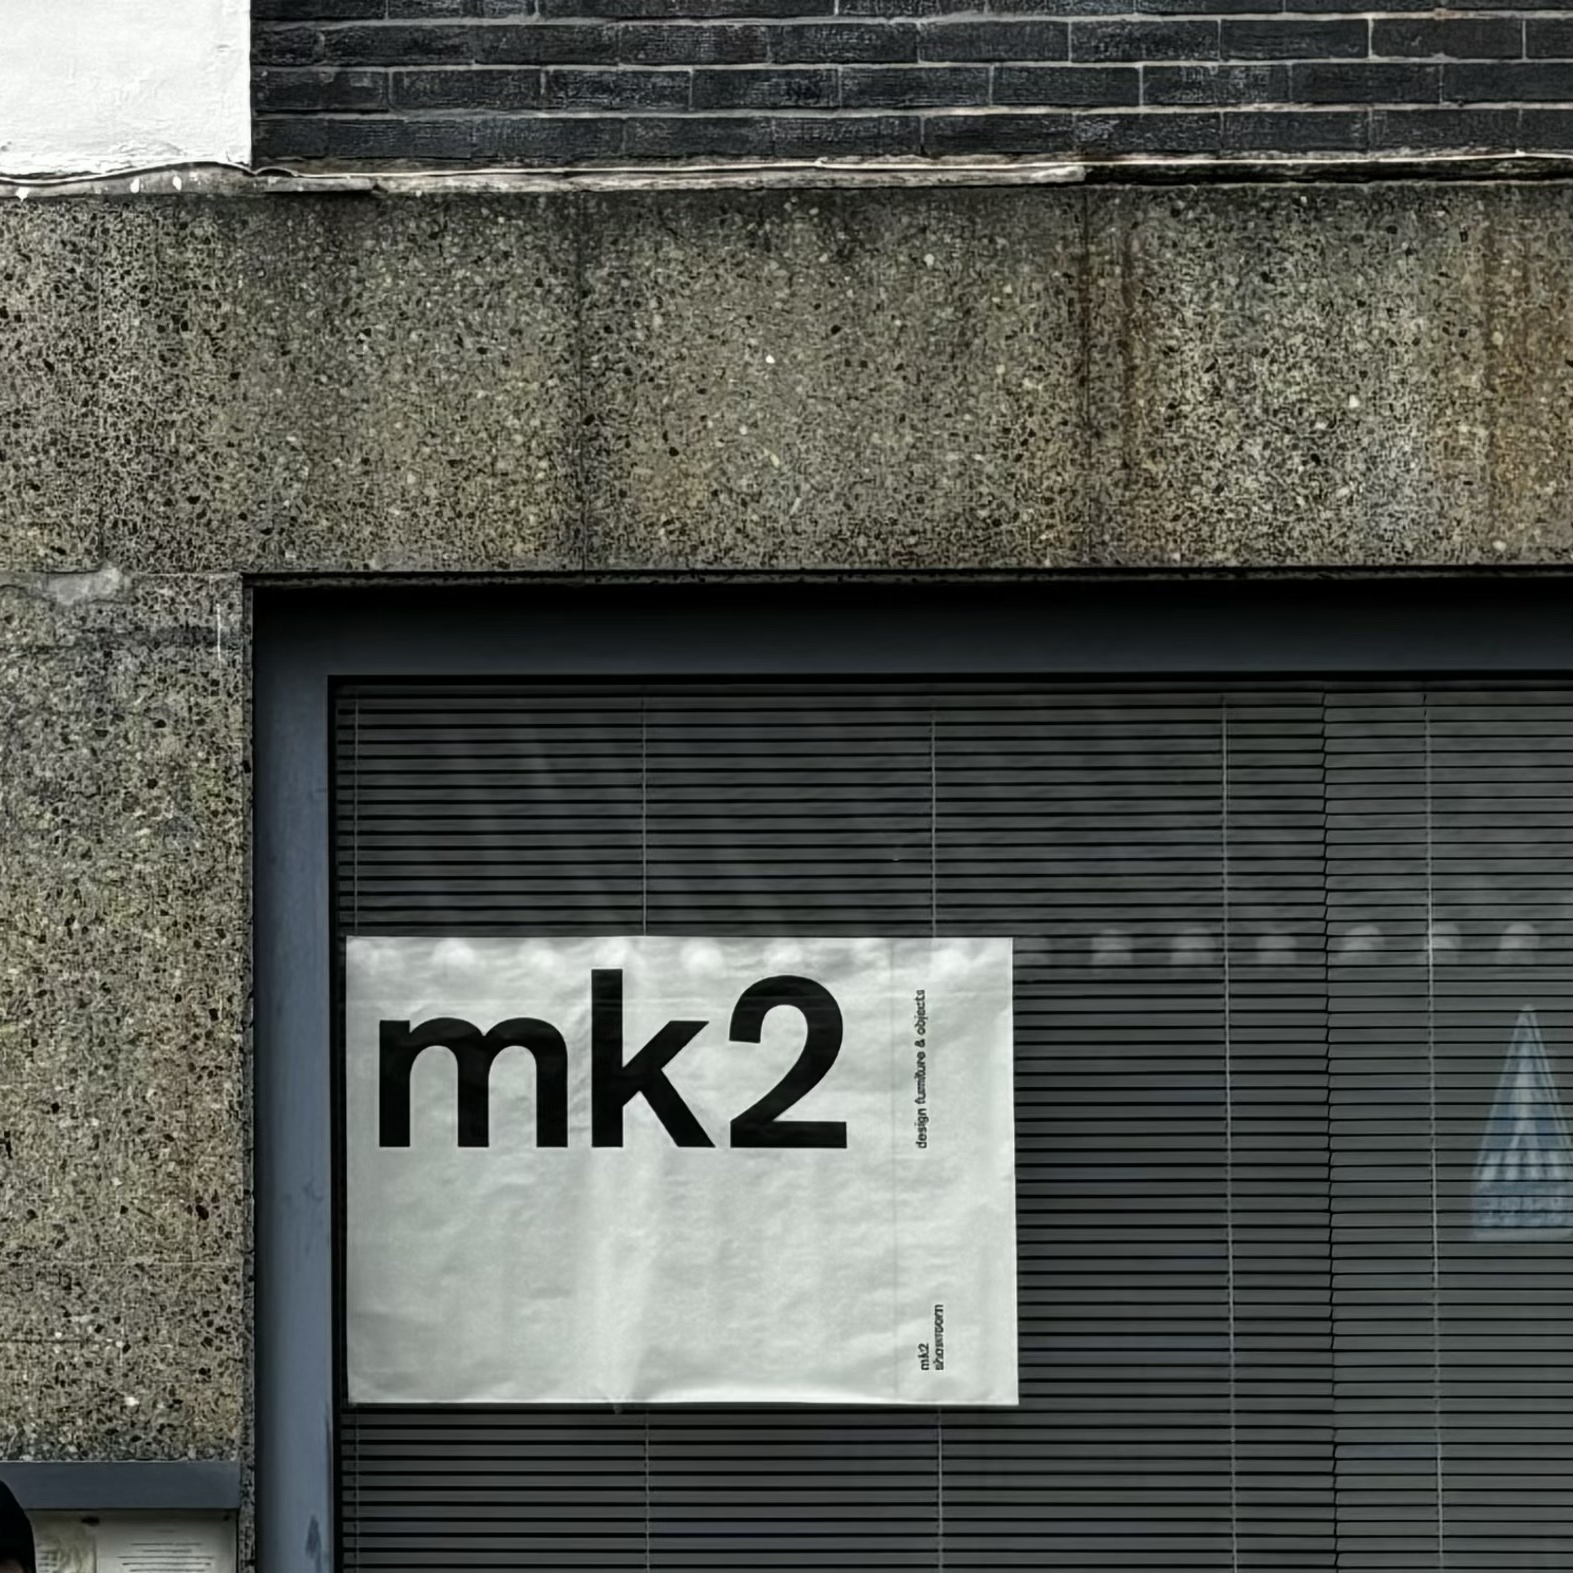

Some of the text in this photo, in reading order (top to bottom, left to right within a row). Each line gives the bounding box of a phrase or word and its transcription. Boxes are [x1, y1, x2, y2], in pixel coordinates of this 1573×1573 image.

[378, 968, 848, 1149] mk2
[913, 989, 930, 1149] design furniture & objects
[917, 1304, 944, 1371] mk2 showroom
